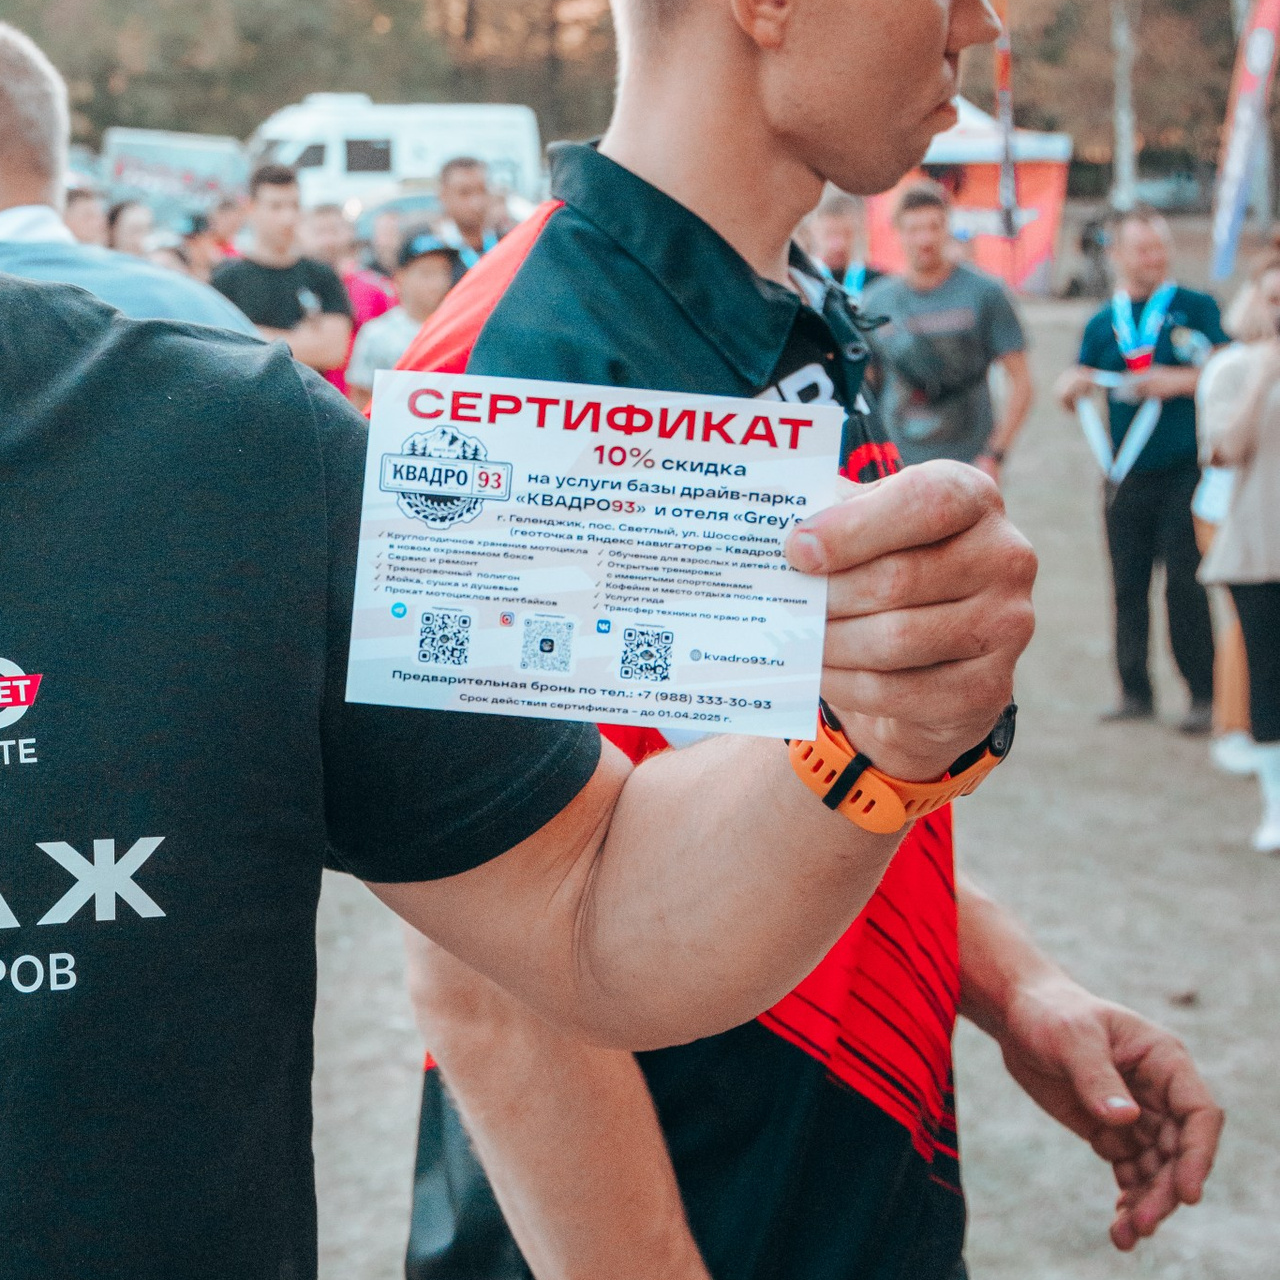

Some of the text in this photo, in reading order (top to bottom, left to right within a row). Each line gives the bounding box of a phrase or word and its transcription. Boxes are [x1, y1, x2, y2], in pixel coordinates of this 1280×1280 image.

[409, 389, 813, 450] СЕРТИФИКАТ
[594, 445, 747, 477] 10% скидка
[392, 463, 502, 490] КВАДРО 93
[528, 474, 807, 507] на услуги базы драйв-парка
[516, 492, 646, 513] «КВАДРО93»
[654, 506, 666, 516] и
[671, 507, 729, 521] отеля
[509, 514, 585, 529] Геленджик,
[588, 522, 615, 531] пос.
[618, 523, 678, 537] Светлый,
[681, 530, 699, 539] ул.
[510, 527, 573, 540] (геоточка
[586, 533, 633, 545] Яндекс
[636, 540, 712, 552] навигаторе
[529, 545, 588, 554] мотоцикла
[387, 552, 427, 562] Сервис
[426, 579, 459, 587] сушка
[476, 572, 520, 581] полигон
[384, 585, 424, 595] Прокат
[425, 590, 491, 601] мотоциклов
[501, 596, 558, 606] питбайков
[605, 593, 640, 603] Услуги
[733, 593, 764, 601] после
[603, 603, 654, 615] Трансфер
[655, 609, 697, 617] техники
[750, 615, 767, 623] РФ
[704, 652, 785, 666] kvadro93.ru
[392, 670, 772, 710] Предварительная бронь по тел.: +7 (988) 333-30-93
[459, 693, 488, 703] Срок
[490, 697, 547, 707] действия
[550, 702, 629, 714] сертификата
[639, 709, 655, 717] до
[657, 709, 721, 722] 01.04.2025
